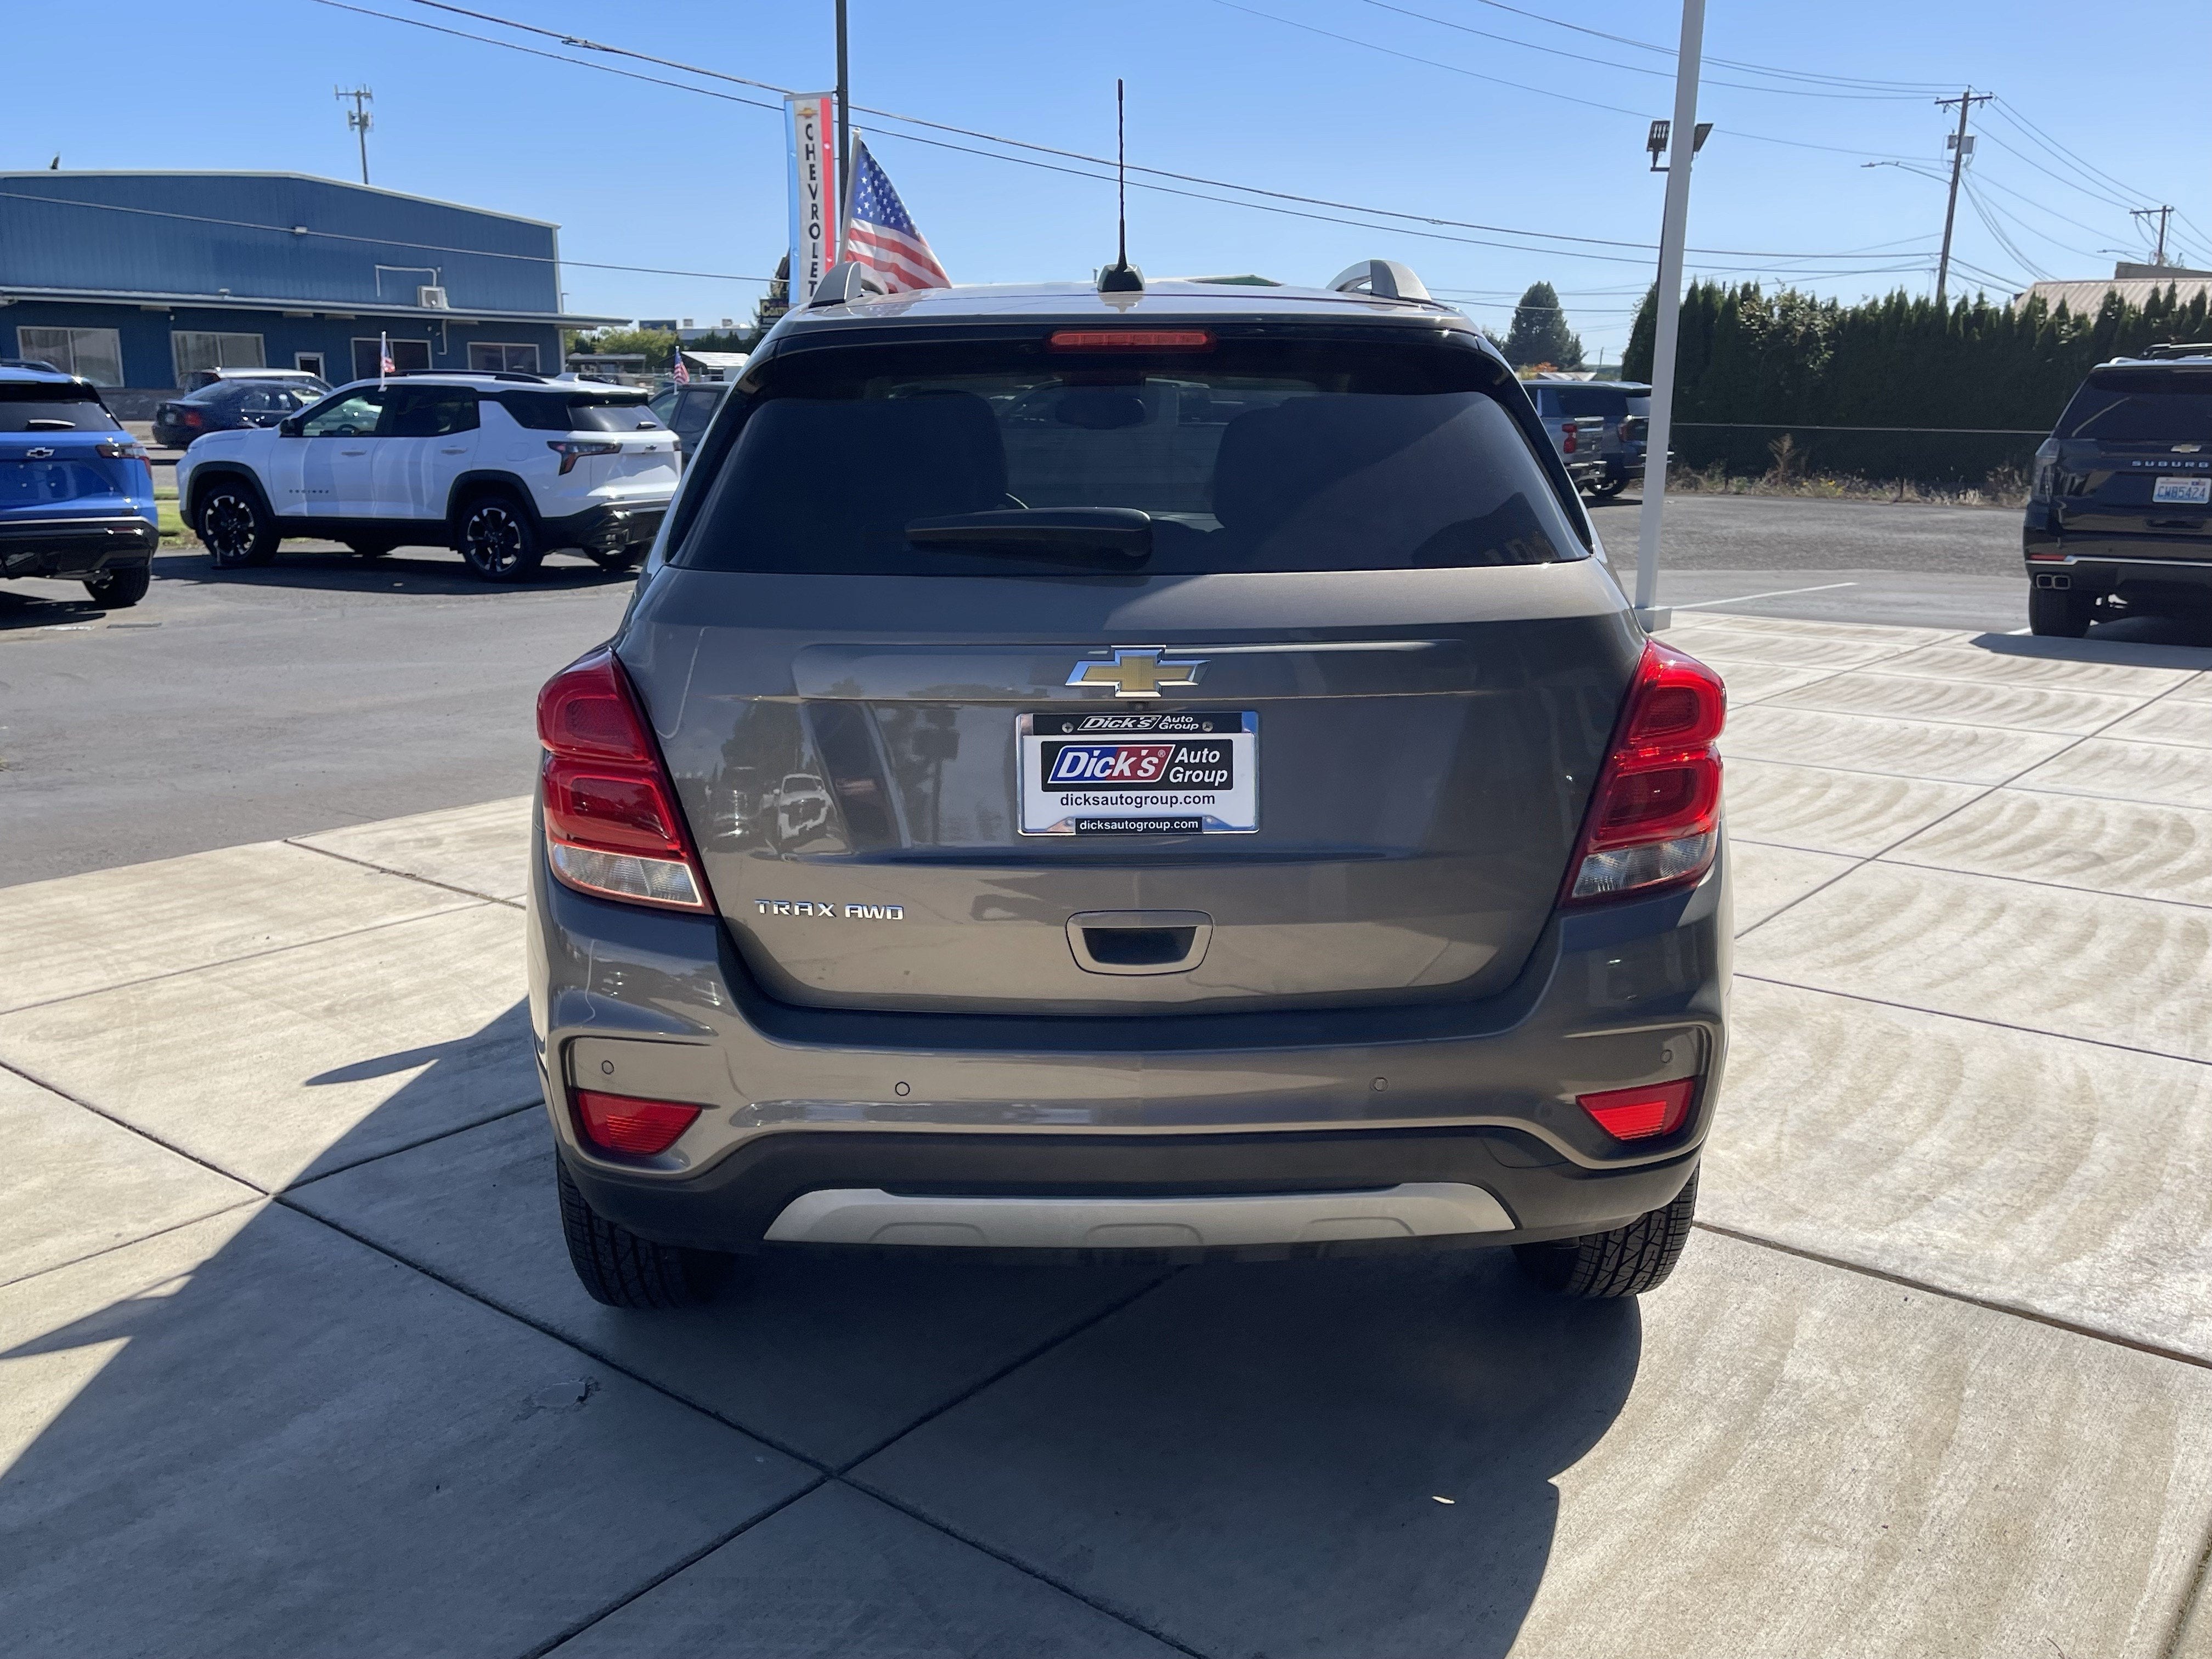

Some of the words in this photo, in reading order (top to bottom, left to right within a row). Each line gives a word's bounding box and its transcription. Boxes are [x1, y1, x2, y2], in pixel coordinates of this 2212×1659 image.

[805, 123, 821, 297] CHEVROLET
[1158, 722, 1199, 731] Group
[1175, 747, 1220, 764] Auto
[1169, 767, 1228, 786] Group
[1060, 793, 1215, 808] dicksautogroup.com
[1079, 819, 1199, 832] dicksautogroup.com
[754, 899, 837, 918] TRAX
[845, 904, 905, 920] AWD
